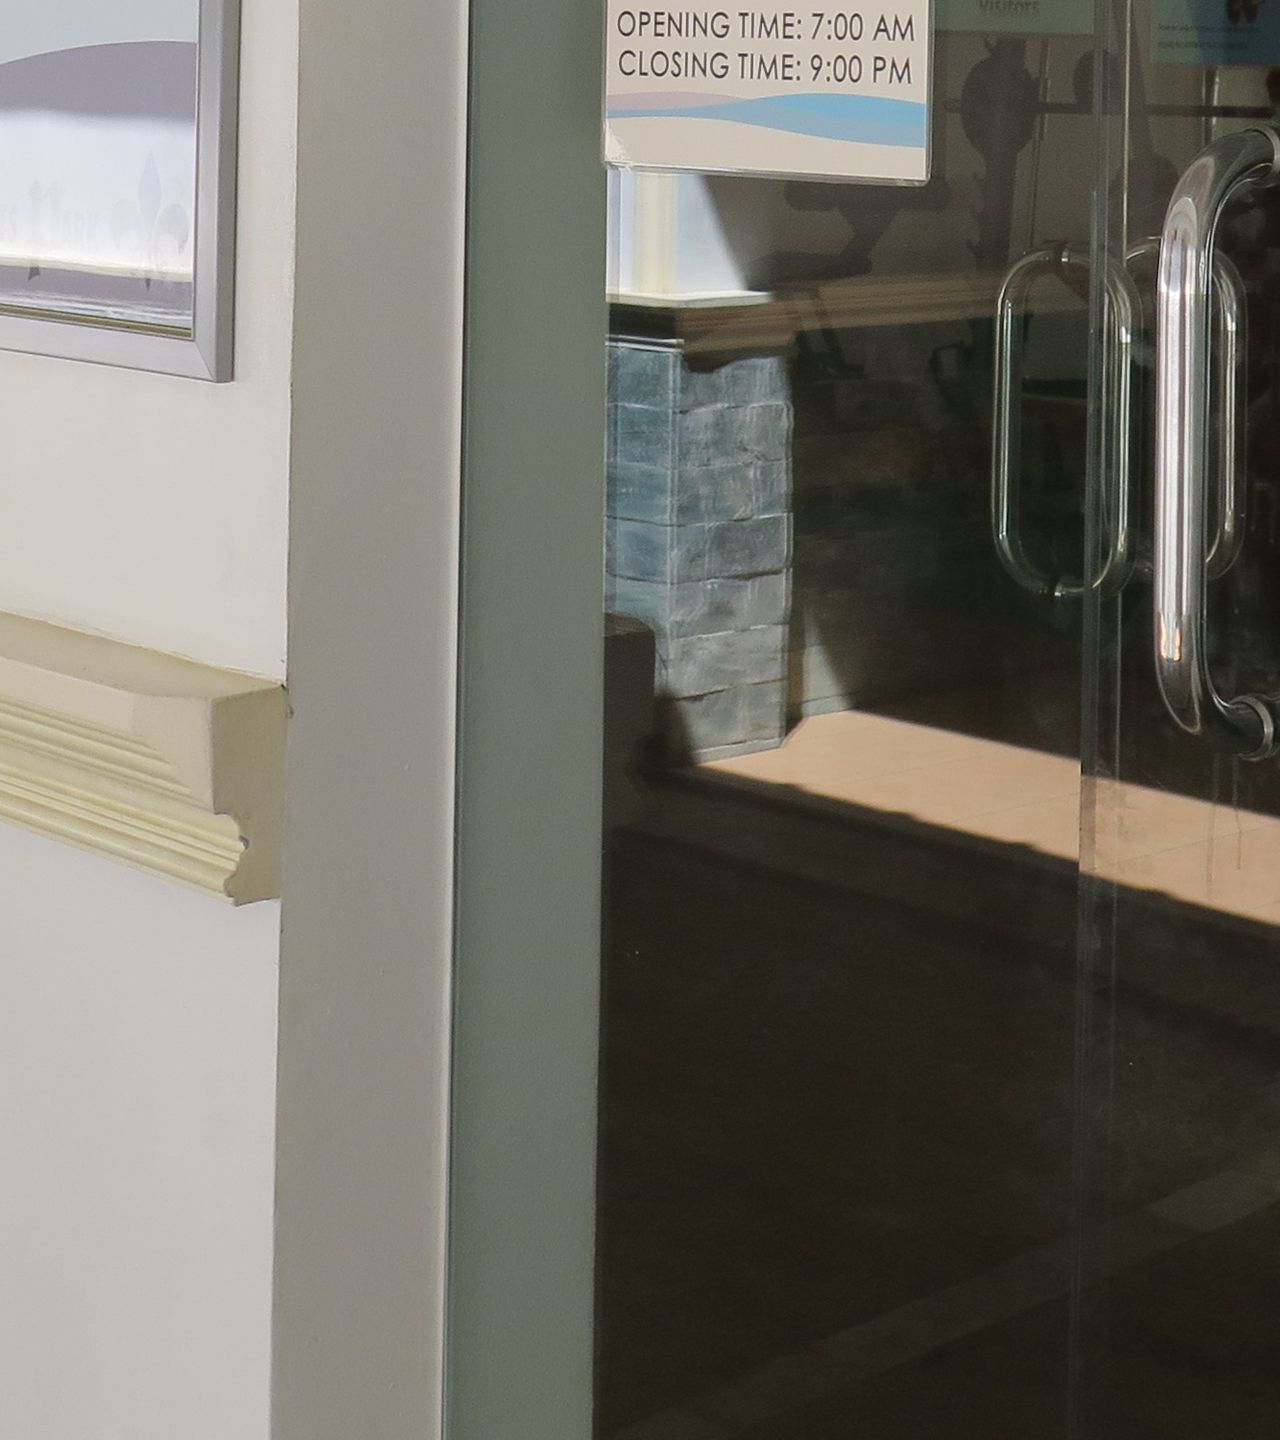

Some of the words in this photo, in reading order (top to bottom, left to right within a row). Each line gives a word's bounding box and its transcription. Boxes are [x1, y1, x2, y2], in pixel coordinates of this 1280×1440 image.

[617, 10, 730, 39] OPENING
[738, 12, 802, 40] TIME:
[811, 12, 863, 41] 7:00
[872, 14, 915, 42] AM
[618, 50, 729, 79] CLOSING
[738, 52, 802, 82] TIME:
[811, 54, 863, 83] 9:00
[873, 56, 913, 84] PM
